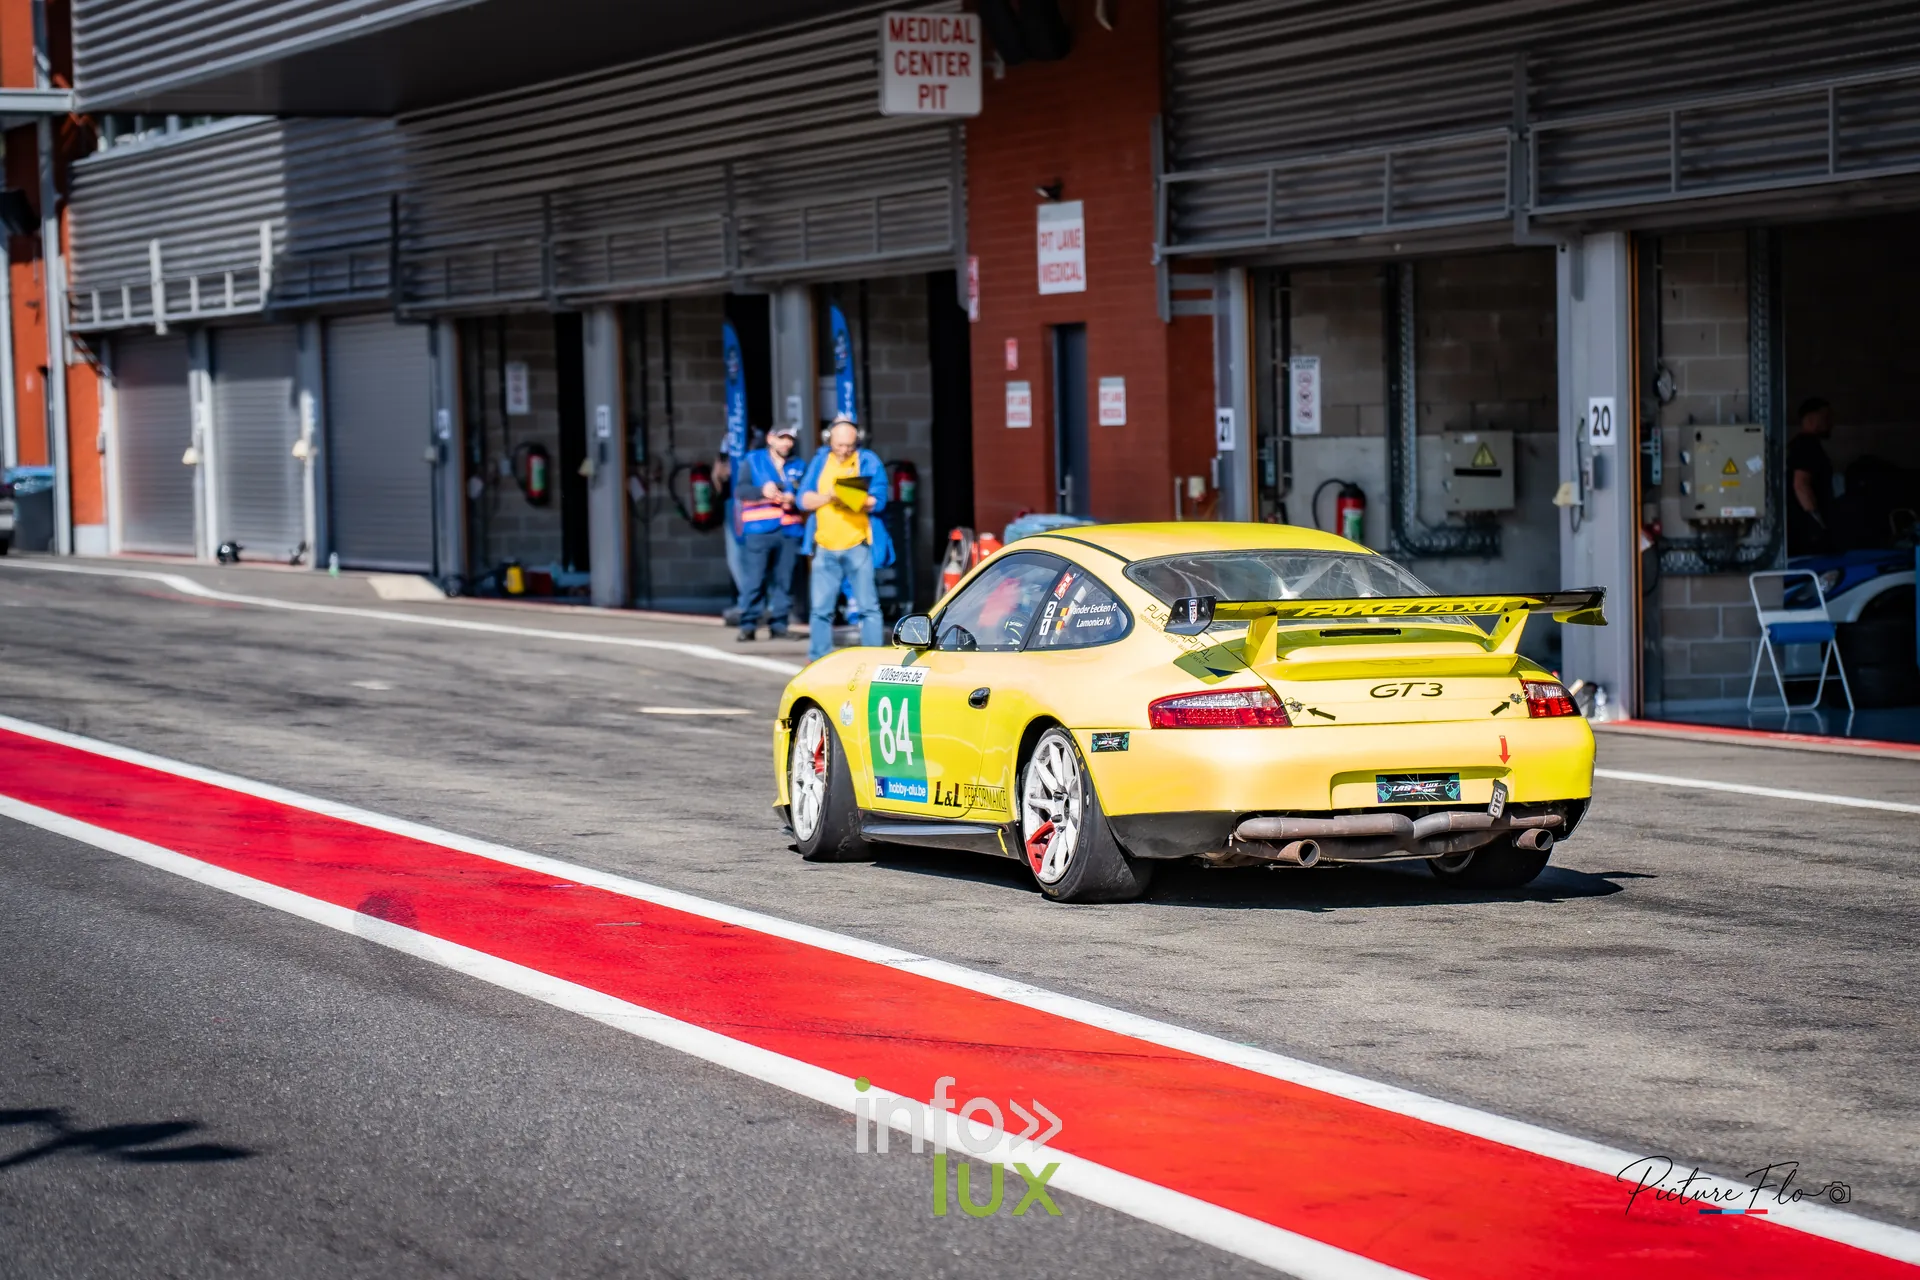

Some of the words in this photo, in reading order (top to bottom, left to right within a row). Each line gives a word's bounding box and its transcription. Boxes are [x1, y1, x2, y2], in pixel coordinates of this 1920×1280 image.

[889, 17, 975, 43] MEDICAL
[895, 50, 970, 76] CENTER
[918, 84, 948, 109] PIT
[1592, 405, 1611, 436] 20
[1045, 603, 1055, 617] 2
[1090, 604, 1110, 613] Eecken
[1294, 603, 1405, 617] FAKE
[1412, 600, 1497, 612] TAXI
[1041, 620, 1049, 634] 1
[1076, 617, 1104, 628] Lamonica
[1144, 604, 1168, 627] PUR
[1176, 634, 1214, 662] APITAL
[878, 668, 923, 683] 100series.be
[1370, 682, 1443, 698] GT3
[878, 696, 914, 766] 84
[888, 781, 926, 797] hobby-alu.be
[934, 781, 962, 808] L&L
[963, 786, 1007, 810] PERFORMANCE
